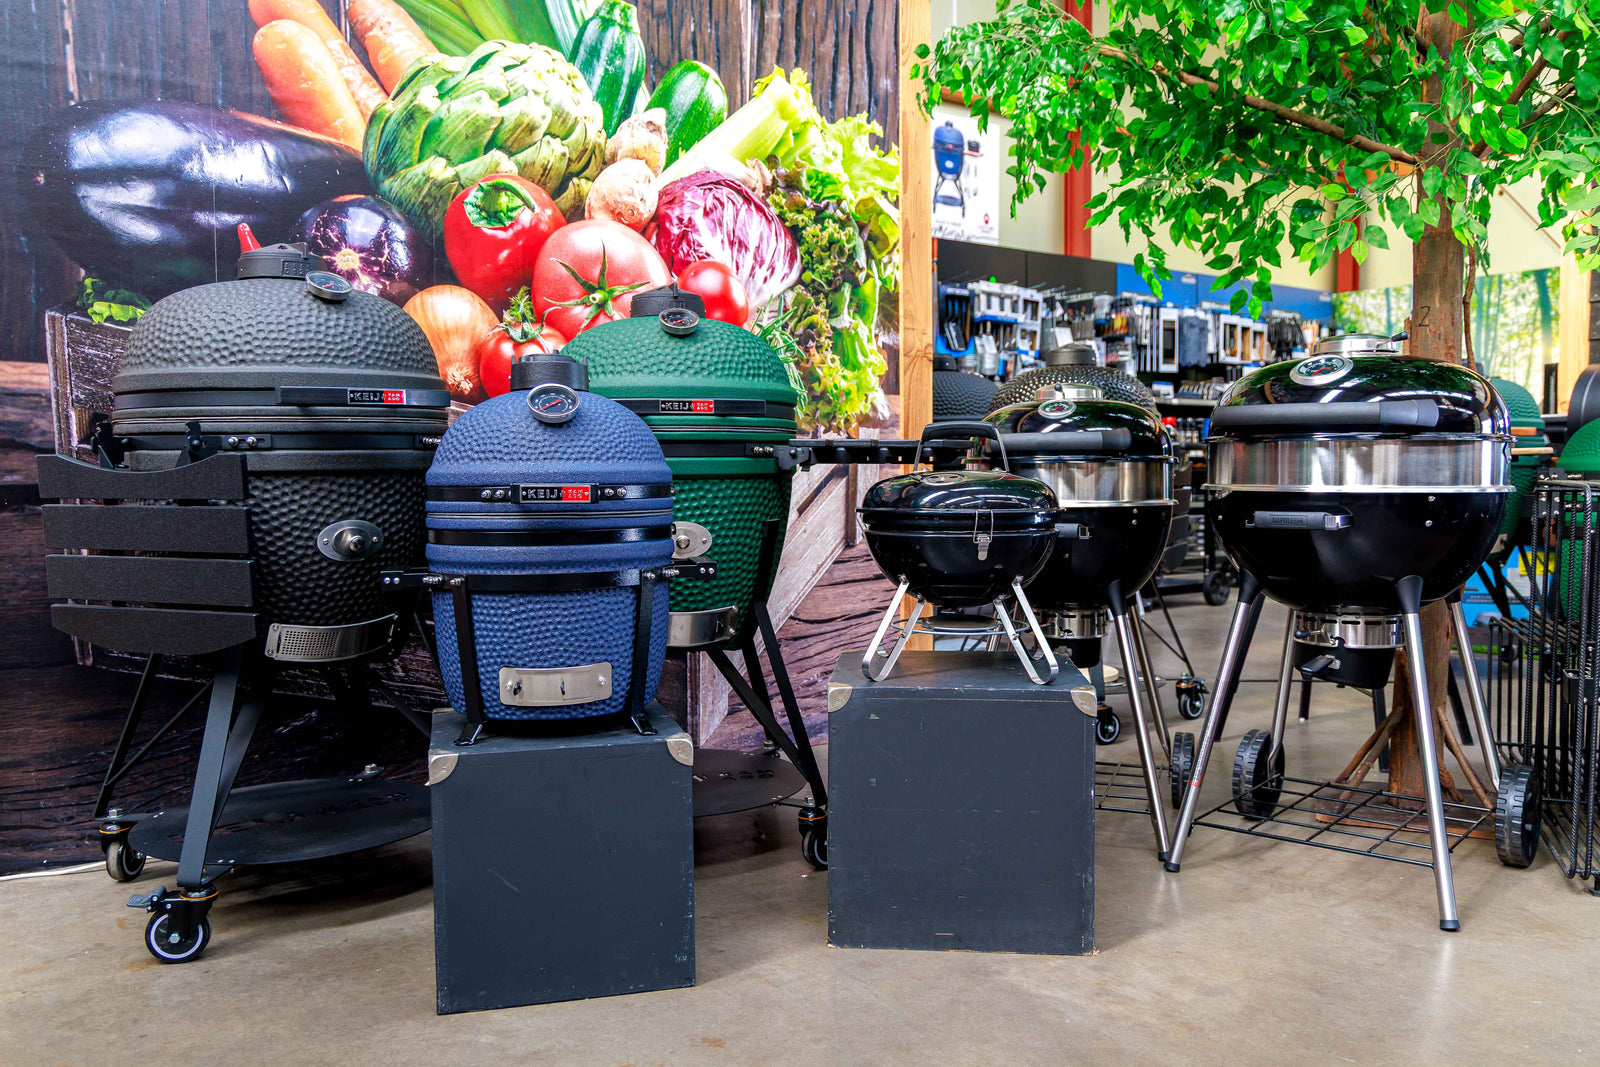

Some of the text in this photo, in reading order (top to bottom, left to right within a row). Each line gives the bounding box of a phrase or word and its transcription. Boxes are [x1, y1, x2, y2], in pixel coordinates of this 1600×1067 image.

[1418, 305, 1430, 327] 2
[354, 392, 380, 401] KEIJ
[665, 402, 689, 410] KEIJ
[527, 489, 558, 499] KEIJ
